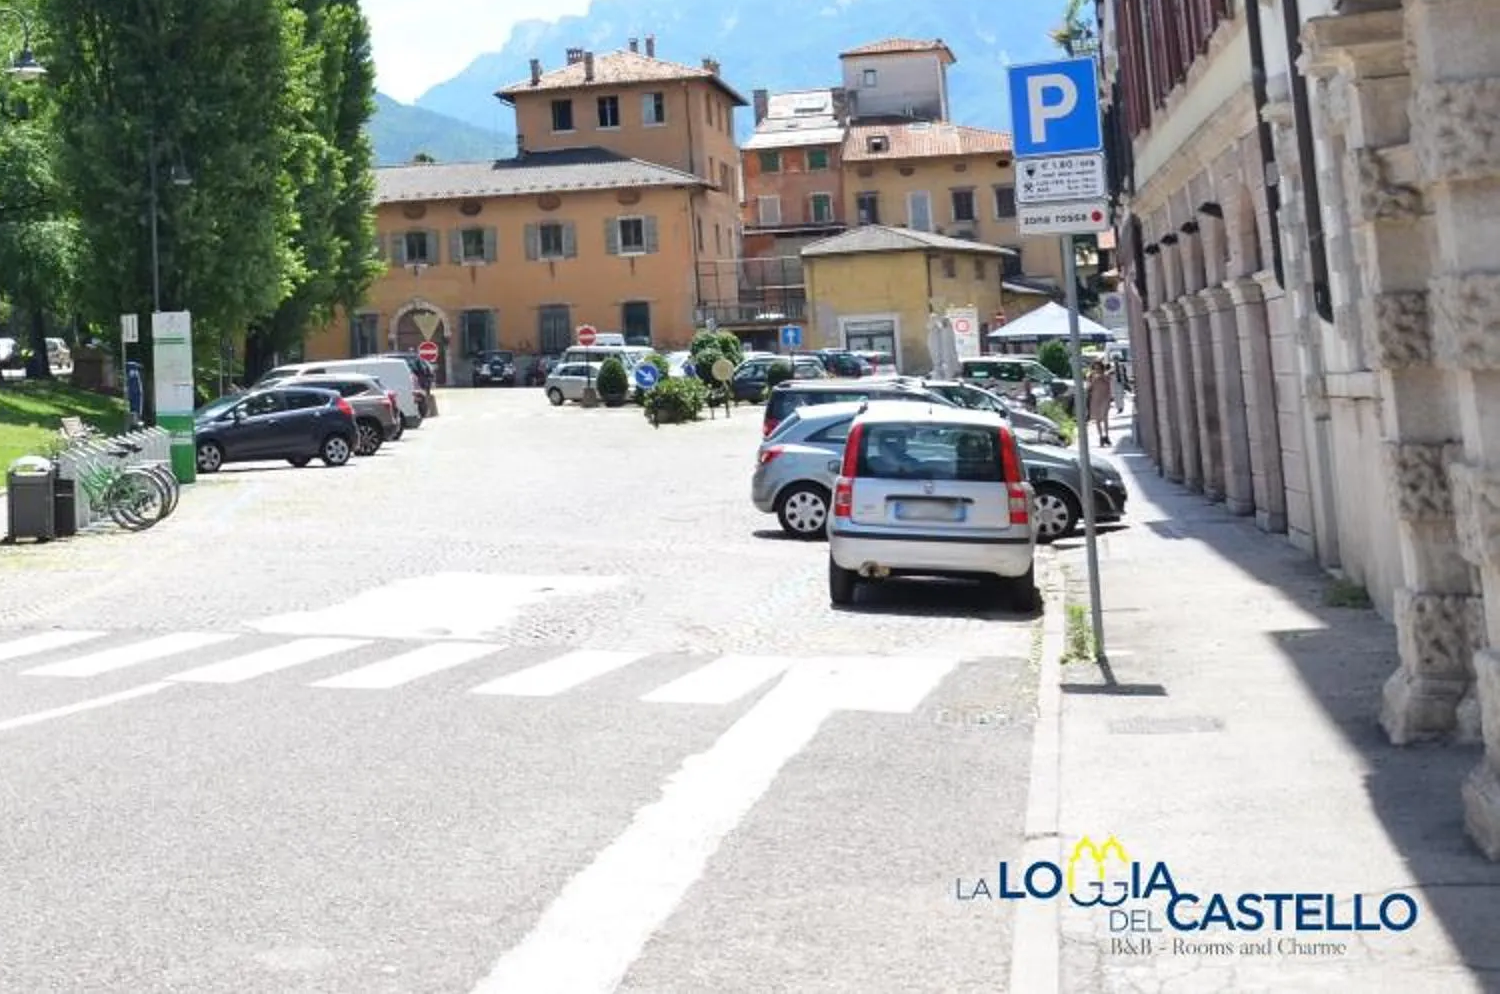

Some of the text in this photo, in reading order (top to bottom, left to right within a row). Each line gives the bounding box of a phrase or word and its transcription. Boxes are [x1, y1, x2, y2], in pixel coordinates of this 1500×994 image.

[1027, 73, 1078, 143] P
[1024, 212, 1088, 225] zona rossa
